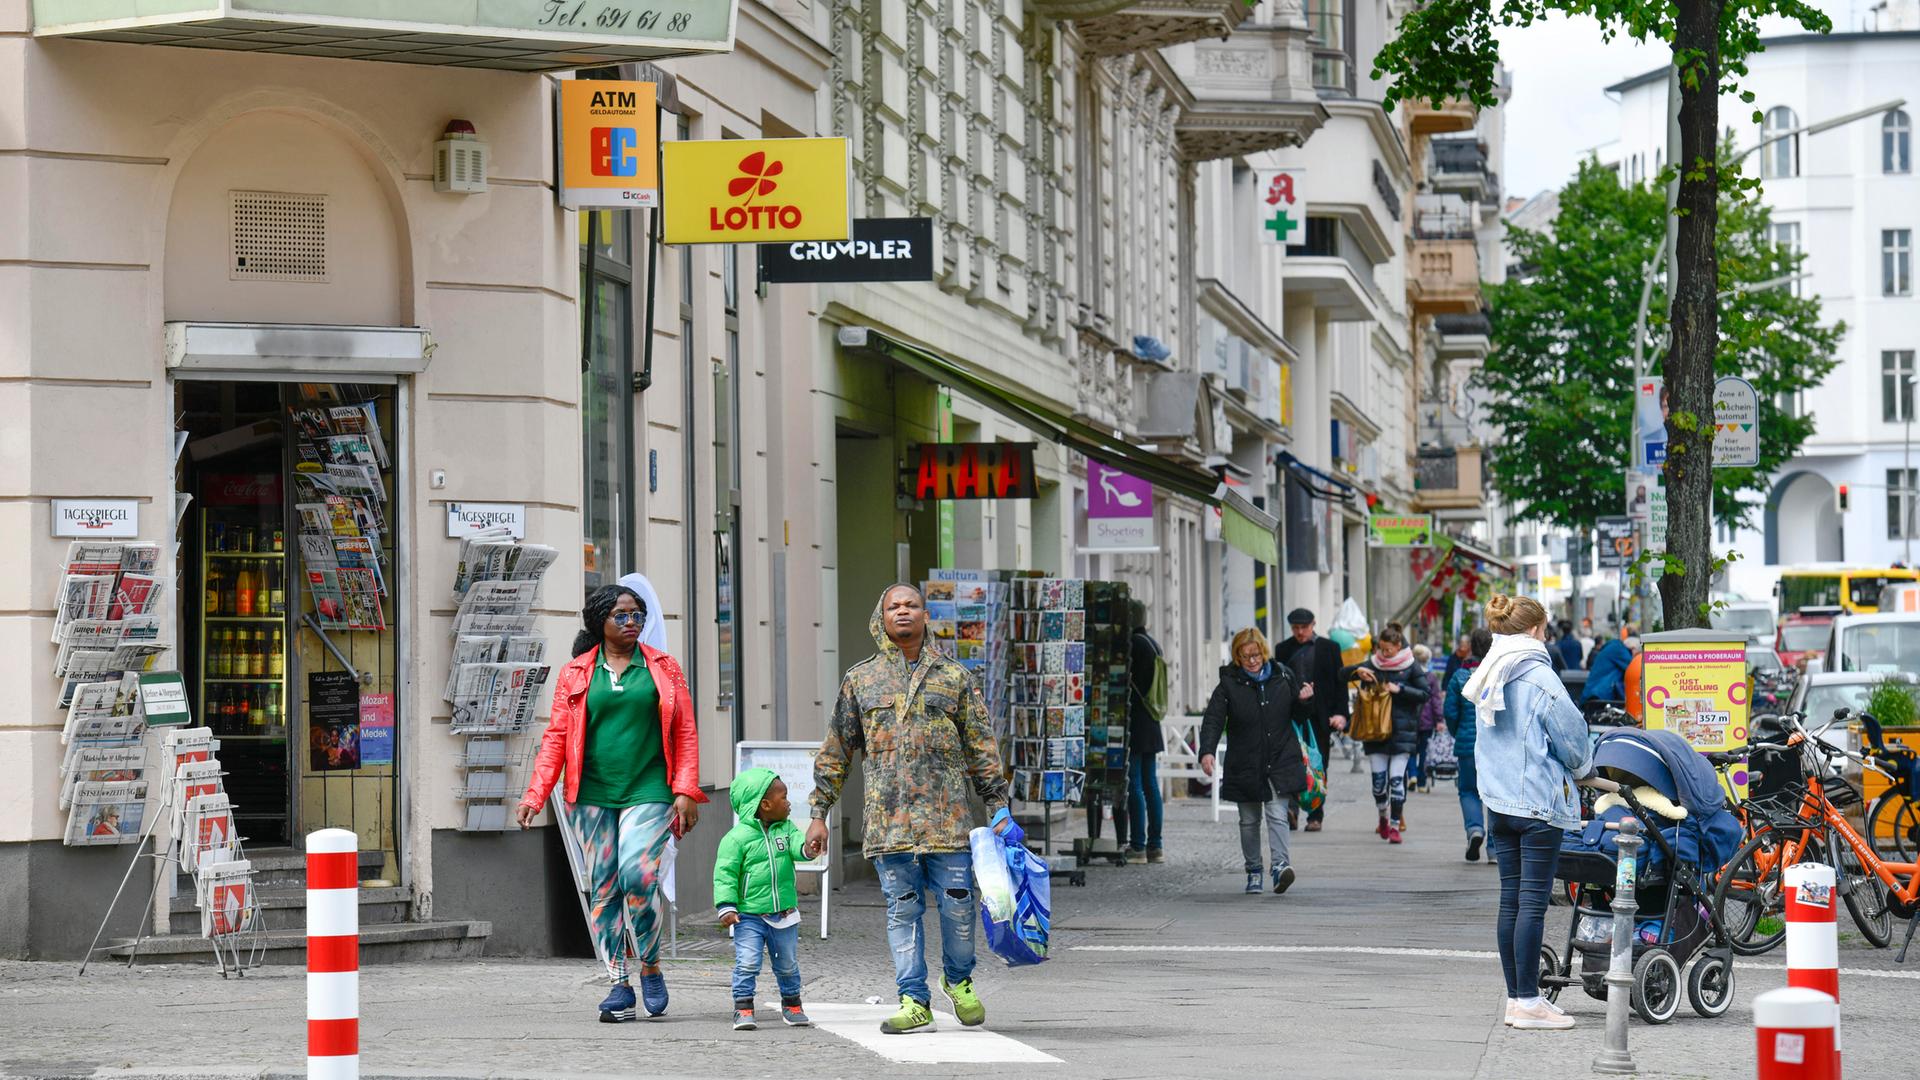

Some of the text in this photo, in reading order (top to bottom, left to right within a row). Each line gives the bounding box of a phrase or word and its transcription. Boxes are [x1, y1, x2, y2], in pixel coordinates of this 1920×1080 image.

[538, 0, 692, 33] Tel. 691 61 88
[590, 91, 636, 108] ATM
[710, 206, 802, 231] LOTTO
[789, 240, 912, 260] CRUMPLER
[1717, 412, 1748, 420] automat
[64, 508, 128, 520] TAGESSPIEGEL
[458, 511, 516, 523] TAGESSPIEGEL
[1097, 523, 1144, 538] Shoeting
[938, 571, 978, 581] Kultura
[361, 695, 388, 705] Mozart
[1700, 714, 1716, 722] 357
